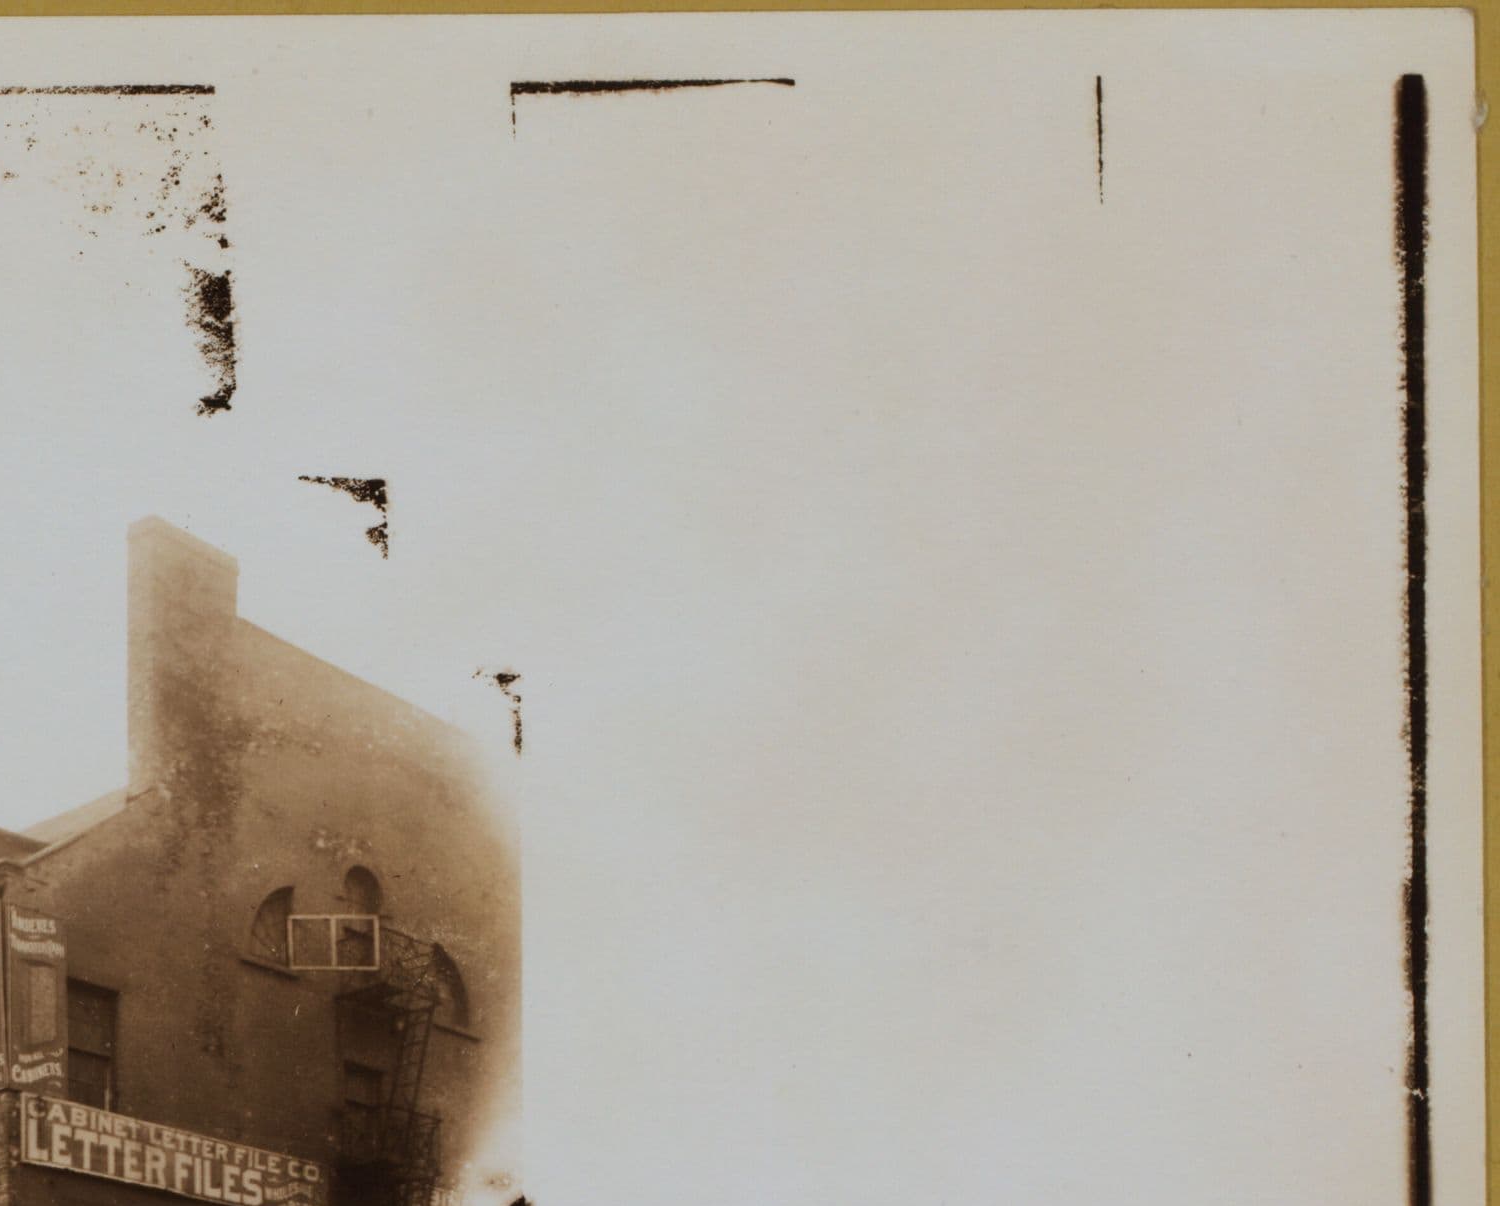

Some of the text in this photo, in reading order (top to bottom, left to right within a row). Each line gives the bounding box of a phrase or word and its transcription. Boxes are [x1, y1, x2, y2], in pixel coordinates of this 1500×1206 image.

[27, 1100, 141, 1139] CABINET
[151, 1125, 229, 1161] LETTER
[235, 1145, 281, 1174] FILE
[27, 1118, 264, 1206] LETTER FILES
